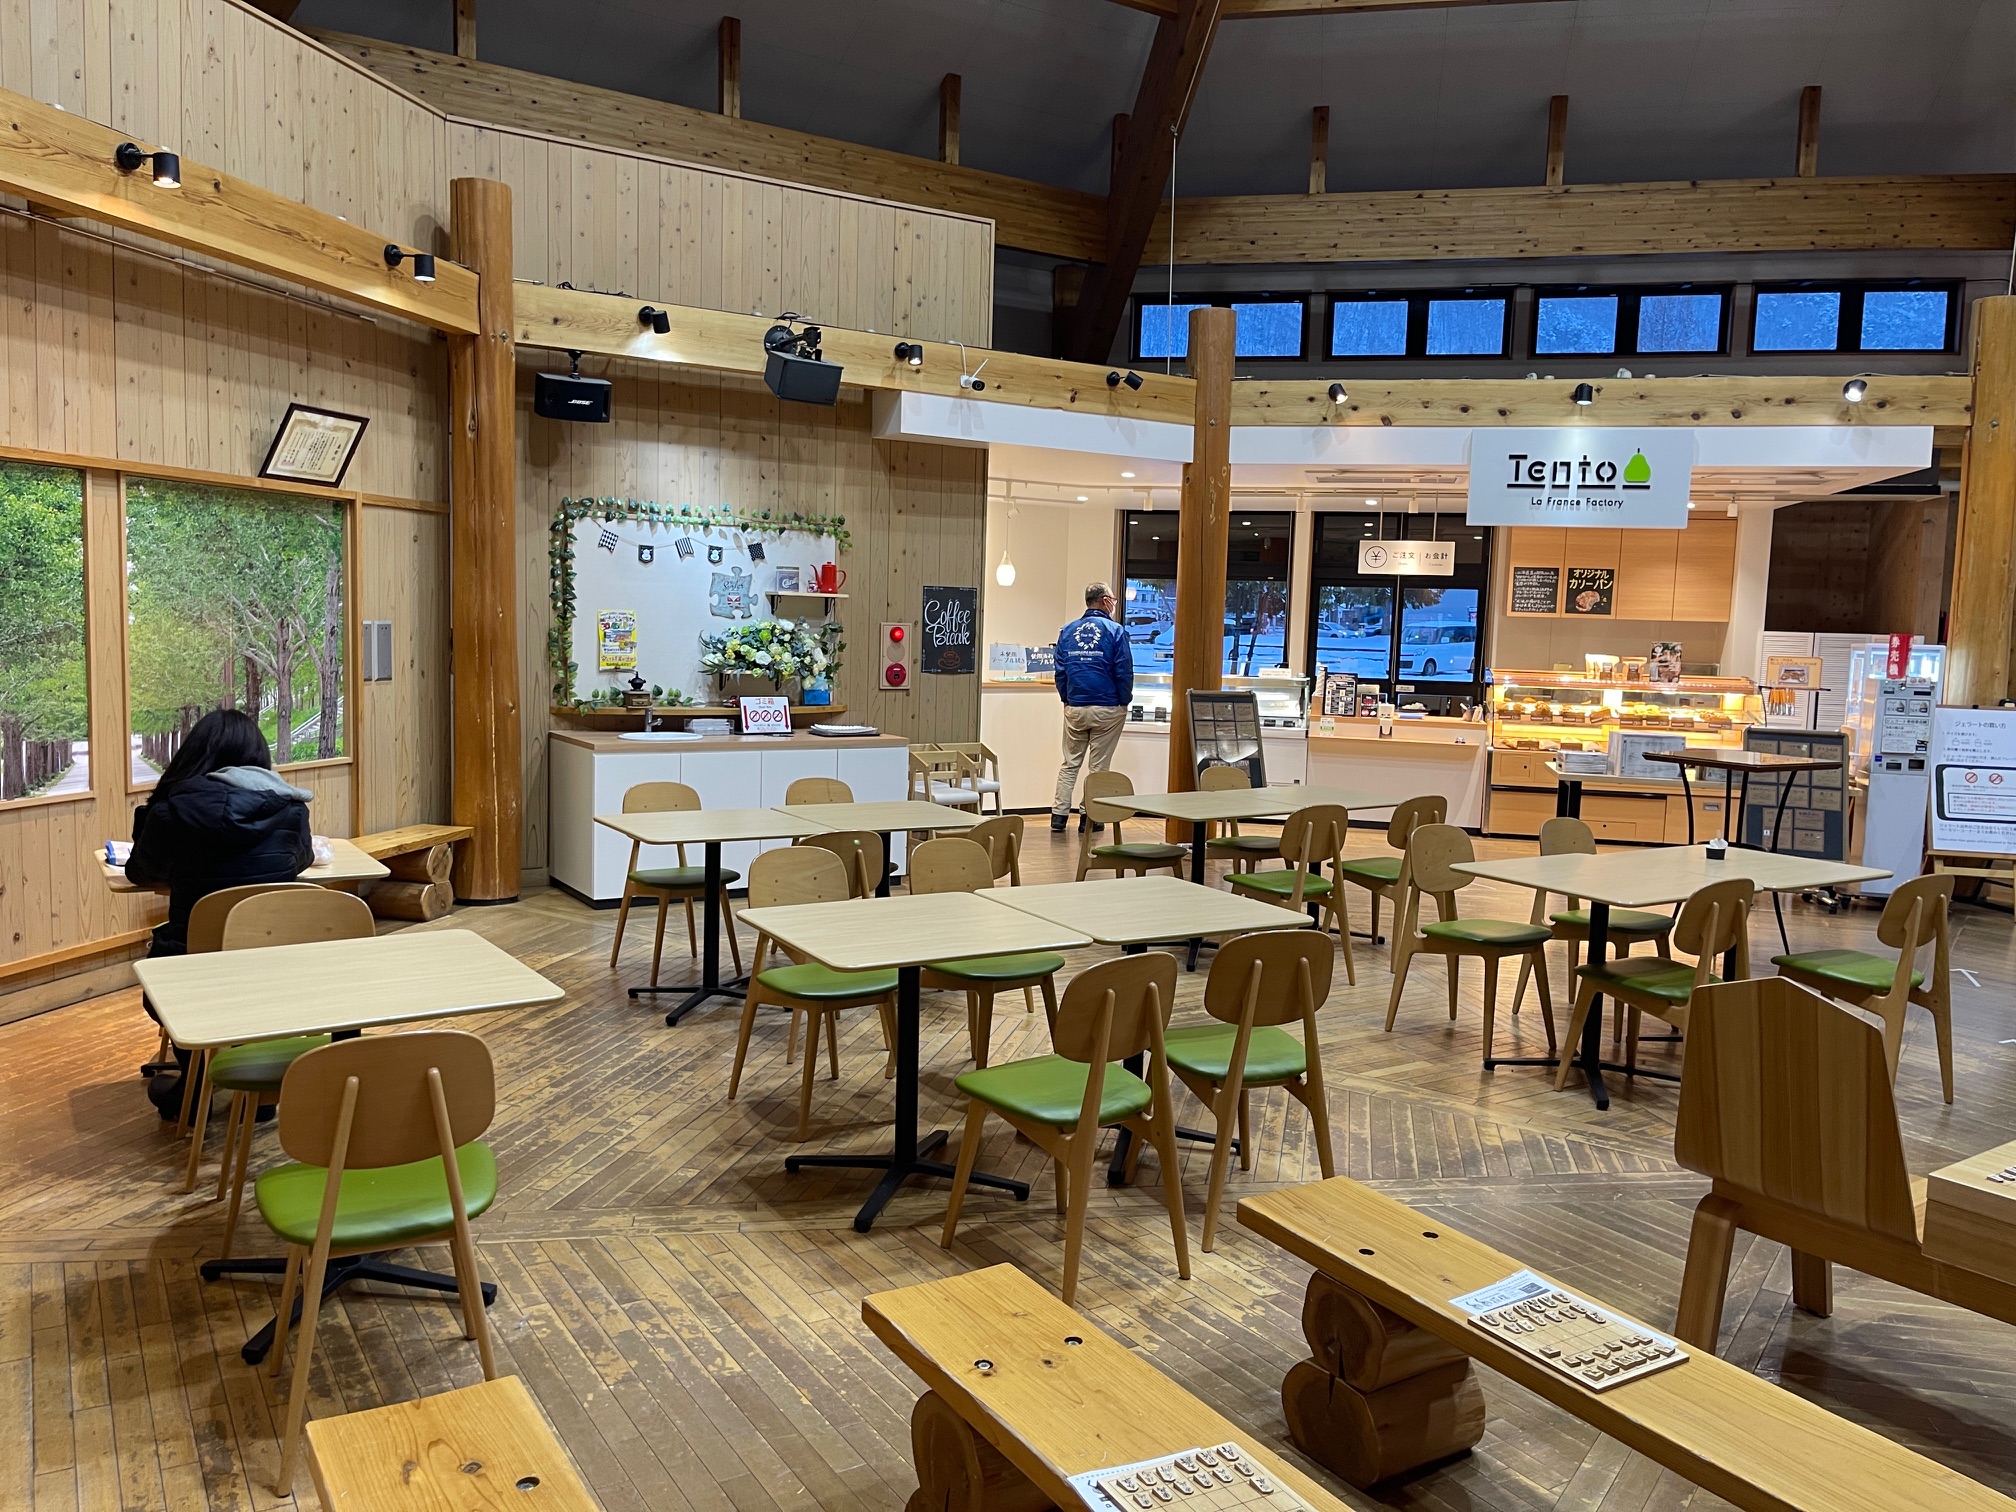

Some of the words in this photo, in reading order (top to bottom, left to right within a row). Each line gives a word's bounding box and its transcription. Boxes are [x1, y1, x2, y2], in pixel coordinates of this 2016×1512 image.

[1508, 454, 1618, 483] Tento
[1531, 497, 1543, 506] La
[1547, 497, 1581, 507] France
[1586, 498, 1624, 509] Factory
[1392, 551, 1415, 559] ご注文
[1425, 552, 1448, 560] お会計
[1573, 569, 1610, 579] オリジナル
[1569, 579, 1613, 589] カリーパン
[924, 599, 971, 632] Coffee
[925, 624, 971, 647] Break
[1889, 636, 1901, 676] 券売機
[1955, 721, 2007, 729] ジェラートの買い方
